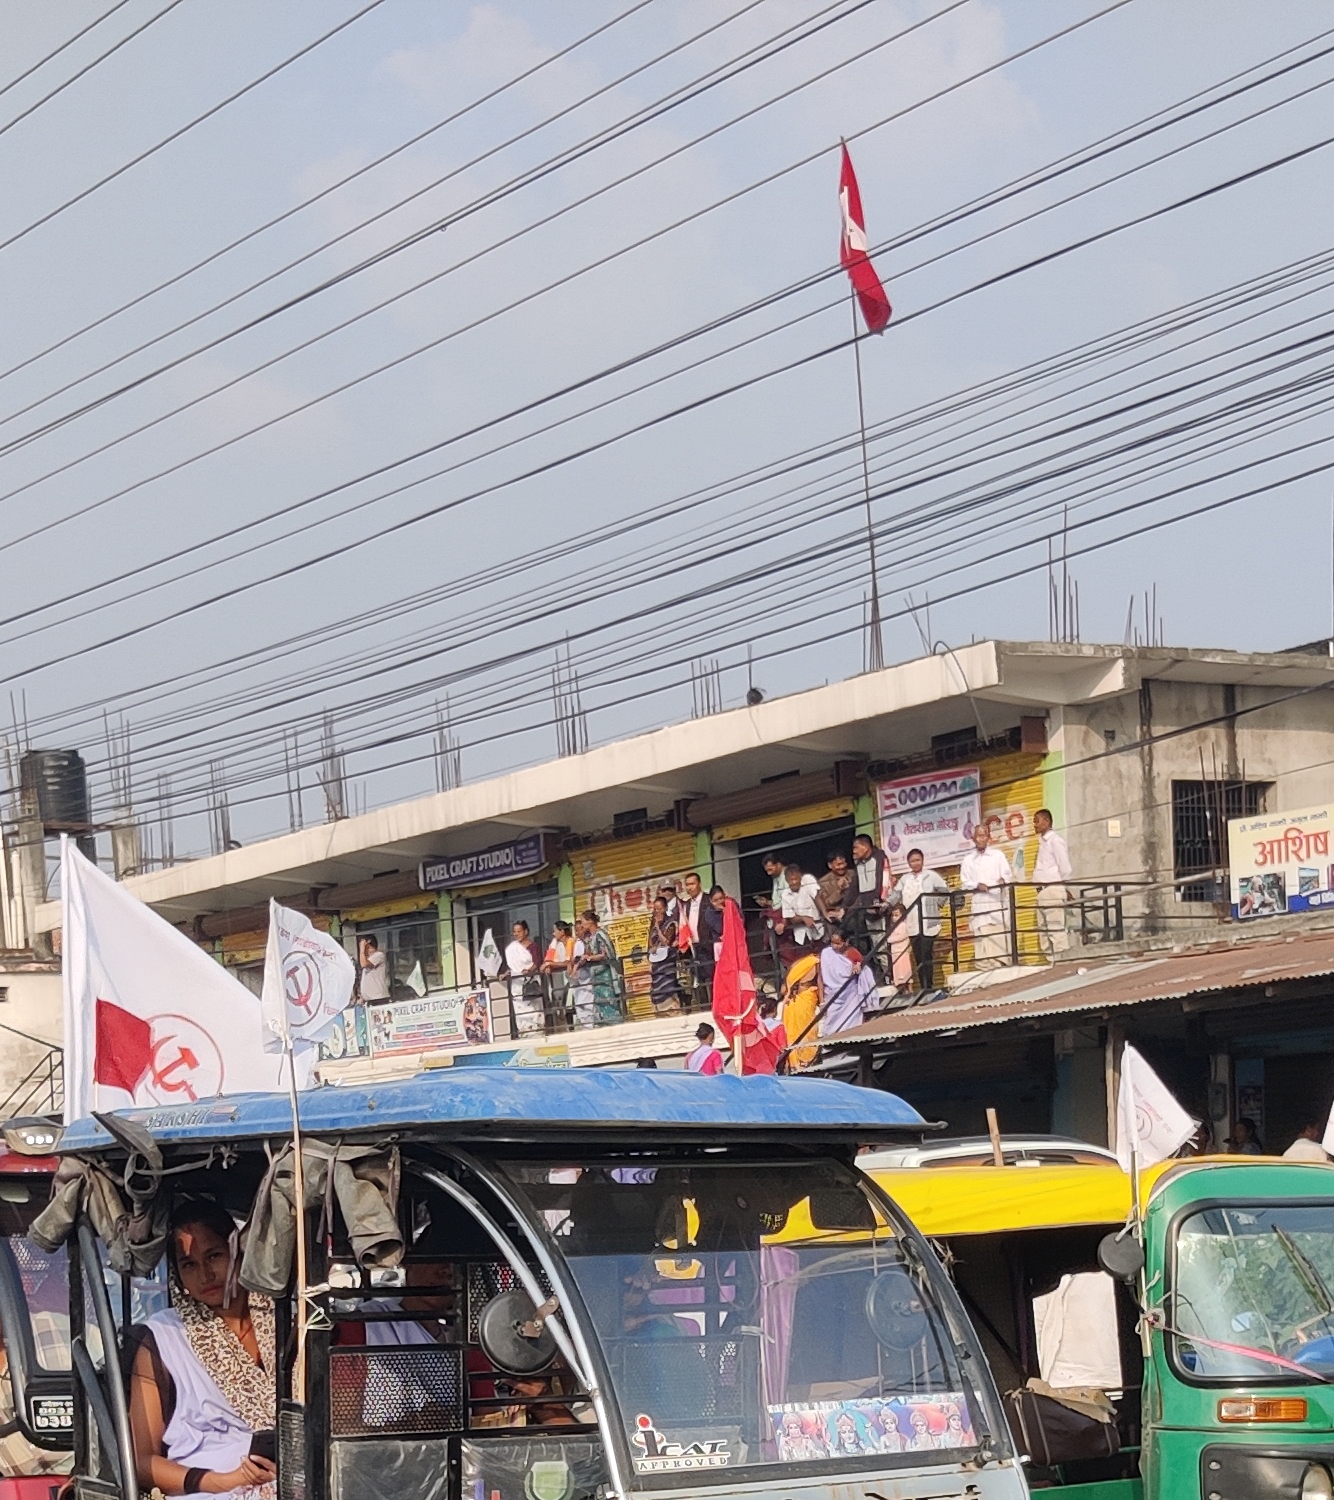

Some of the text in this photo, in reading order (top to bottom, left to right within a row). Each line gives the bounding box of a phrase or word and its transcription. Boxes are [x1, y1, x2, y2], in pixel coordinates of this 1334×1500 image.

[1253, 827, 1330, 867] आशिष
[426, 864, 450, 883] PIXEL
[450, 856, 478, 877] CRAFT
[478, 848, 512, 871] STUDIO
[411, 1002, 431, 1013] CRAFT
[432, 999, 457, 1011] STUDIO
[146, 1109, 210, 1130] SAKSHI
[639, 1456, 729, 1470] APPROVED
